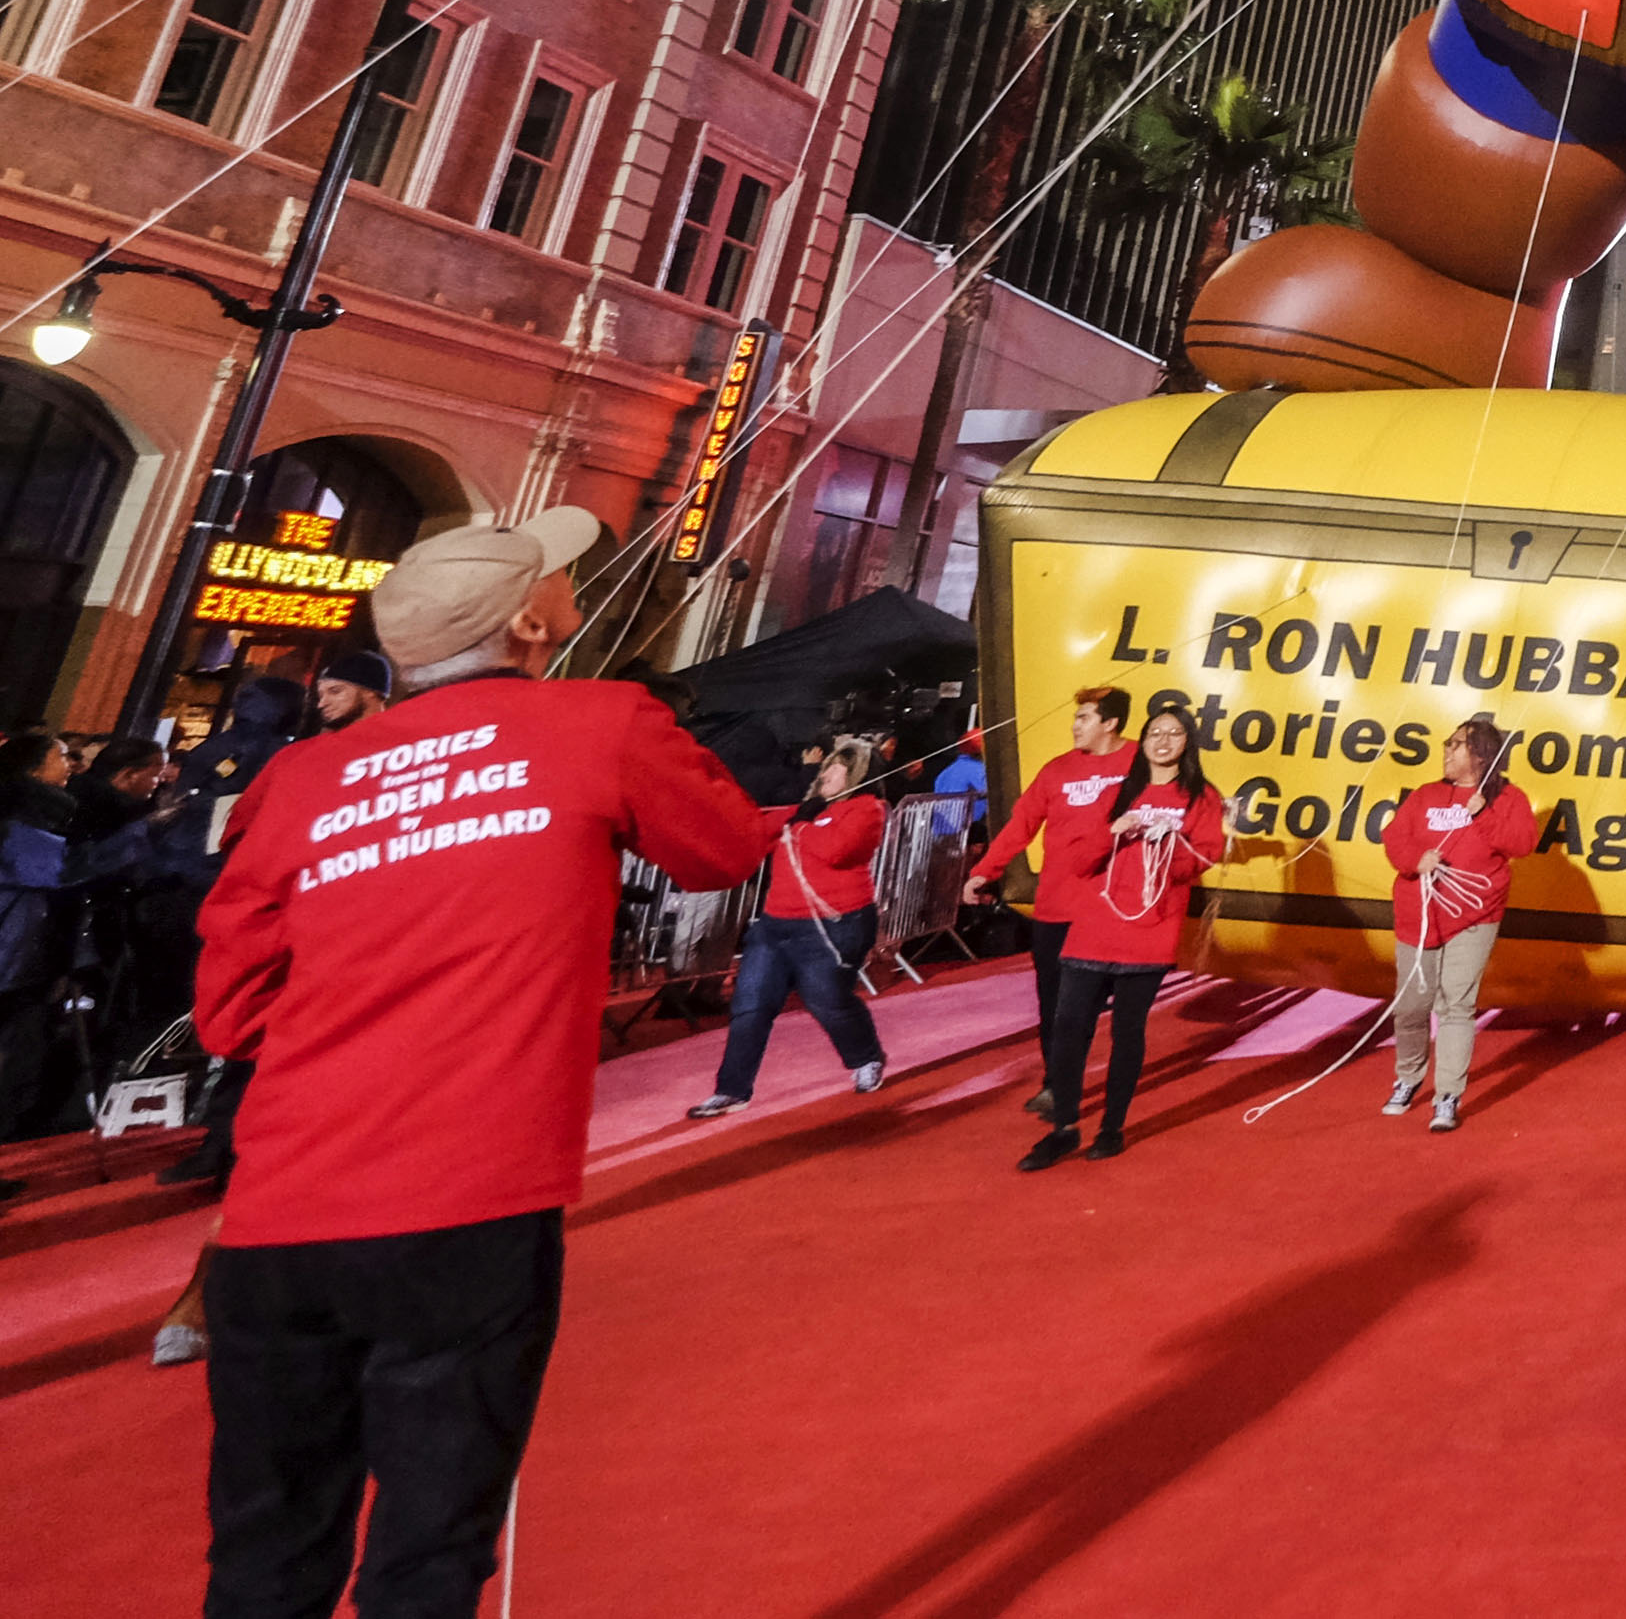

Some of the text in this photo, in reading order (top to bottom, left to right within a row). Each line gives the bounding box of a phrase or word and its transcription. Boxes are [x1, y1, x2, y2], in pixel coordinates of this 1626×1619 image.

[676, 335, 756, 559] SOUVENIRS
[279, 510, 338, 550] THE
[195, 583, 357, 630] EXPERIENCE
[1111, 605, 1170, 664] L.
[1202, 611, 1382, 681] RON
[341, 723, 499, 787] STORIES
[309, 759, 530, 844] GOLDEN AGE
[1234, 776, 1416, 845] Gold
[317, 842, 381, 884] RON
[386, 806, 552, 864] HUBBARD
